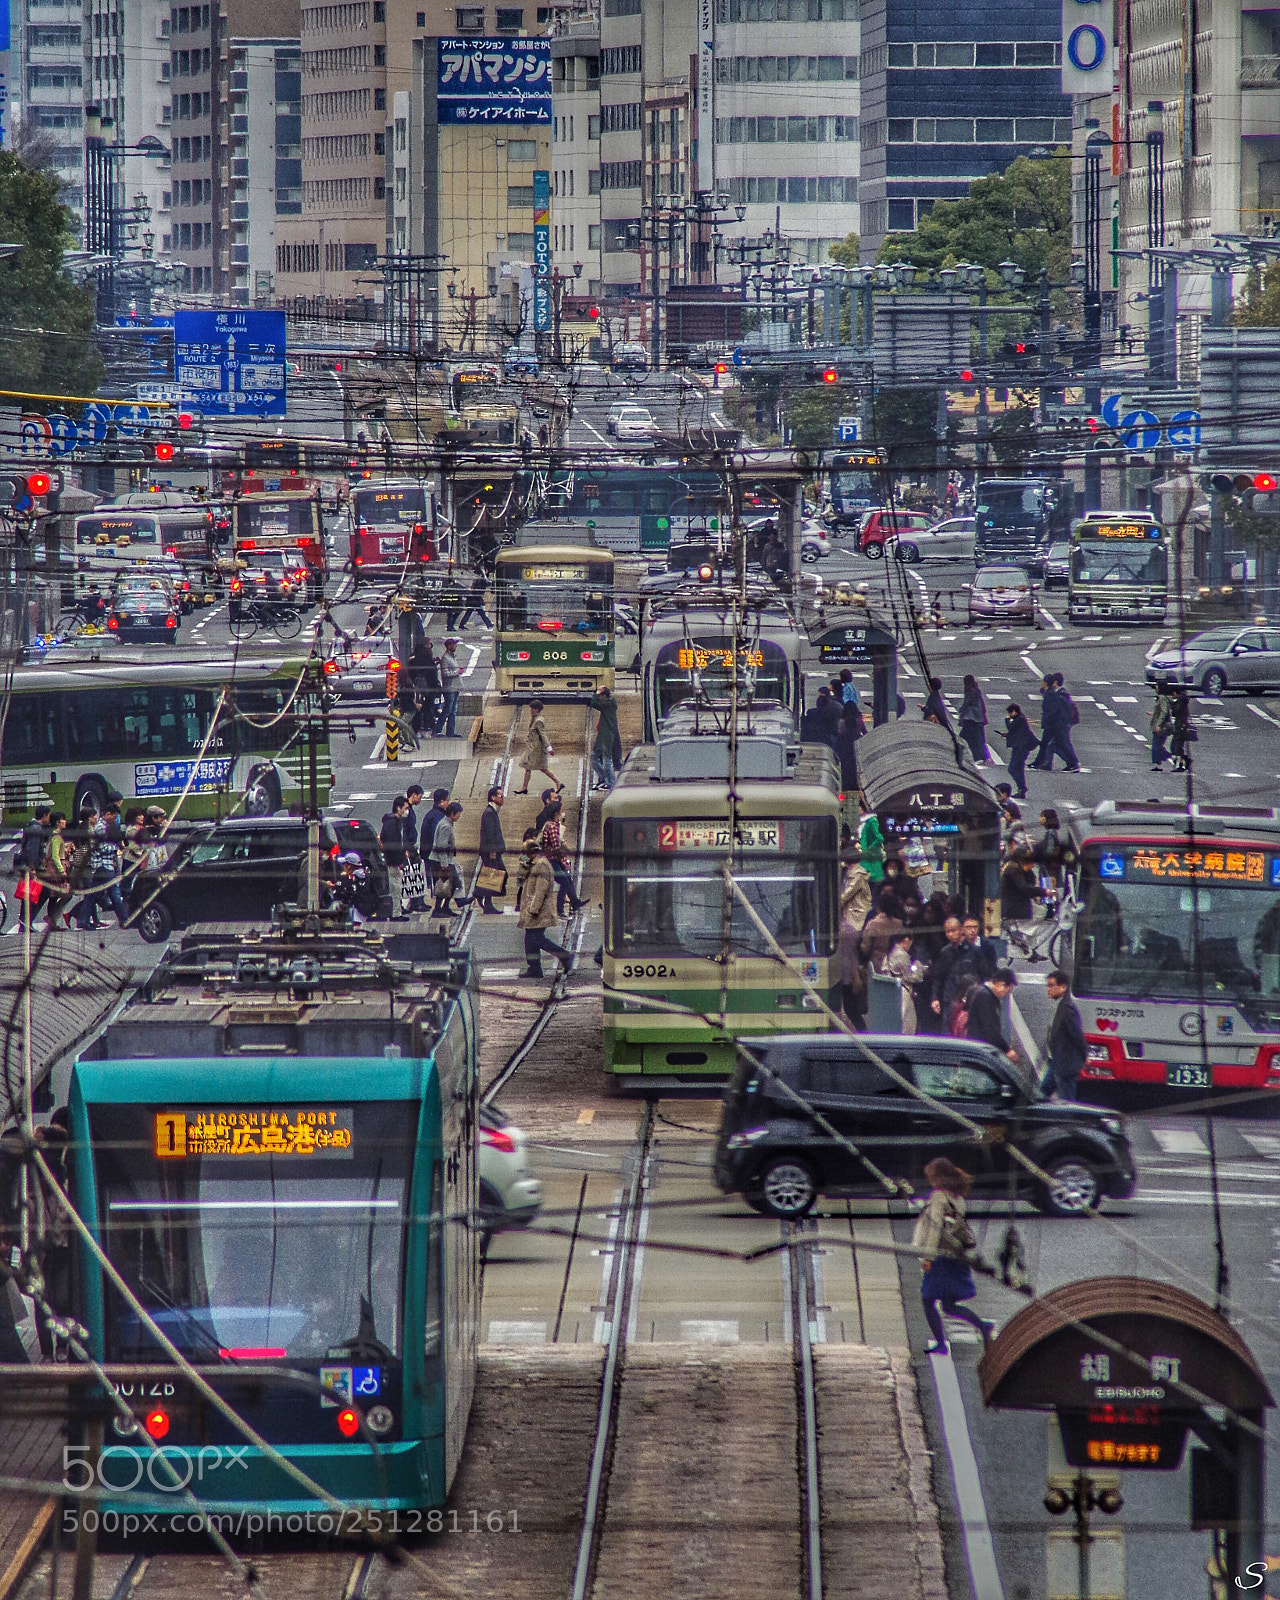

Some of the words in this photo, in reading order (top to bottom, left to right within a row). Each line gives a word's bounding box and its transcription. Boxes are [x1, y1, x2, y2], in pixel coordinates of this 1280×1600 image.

[216, 314, 246, 325] 横川
[842, 426, 853, 440] P
[543, 652, 568, 661] 808
[909, 793, 965, 806] 八丁堀
[661, 824, 674, 846] 2
[715, 830, 777, 847] 広島駅
[197, 1112, 289, 1126] HIROSHIMA
[296, 1111, 338, 1125] PORT
